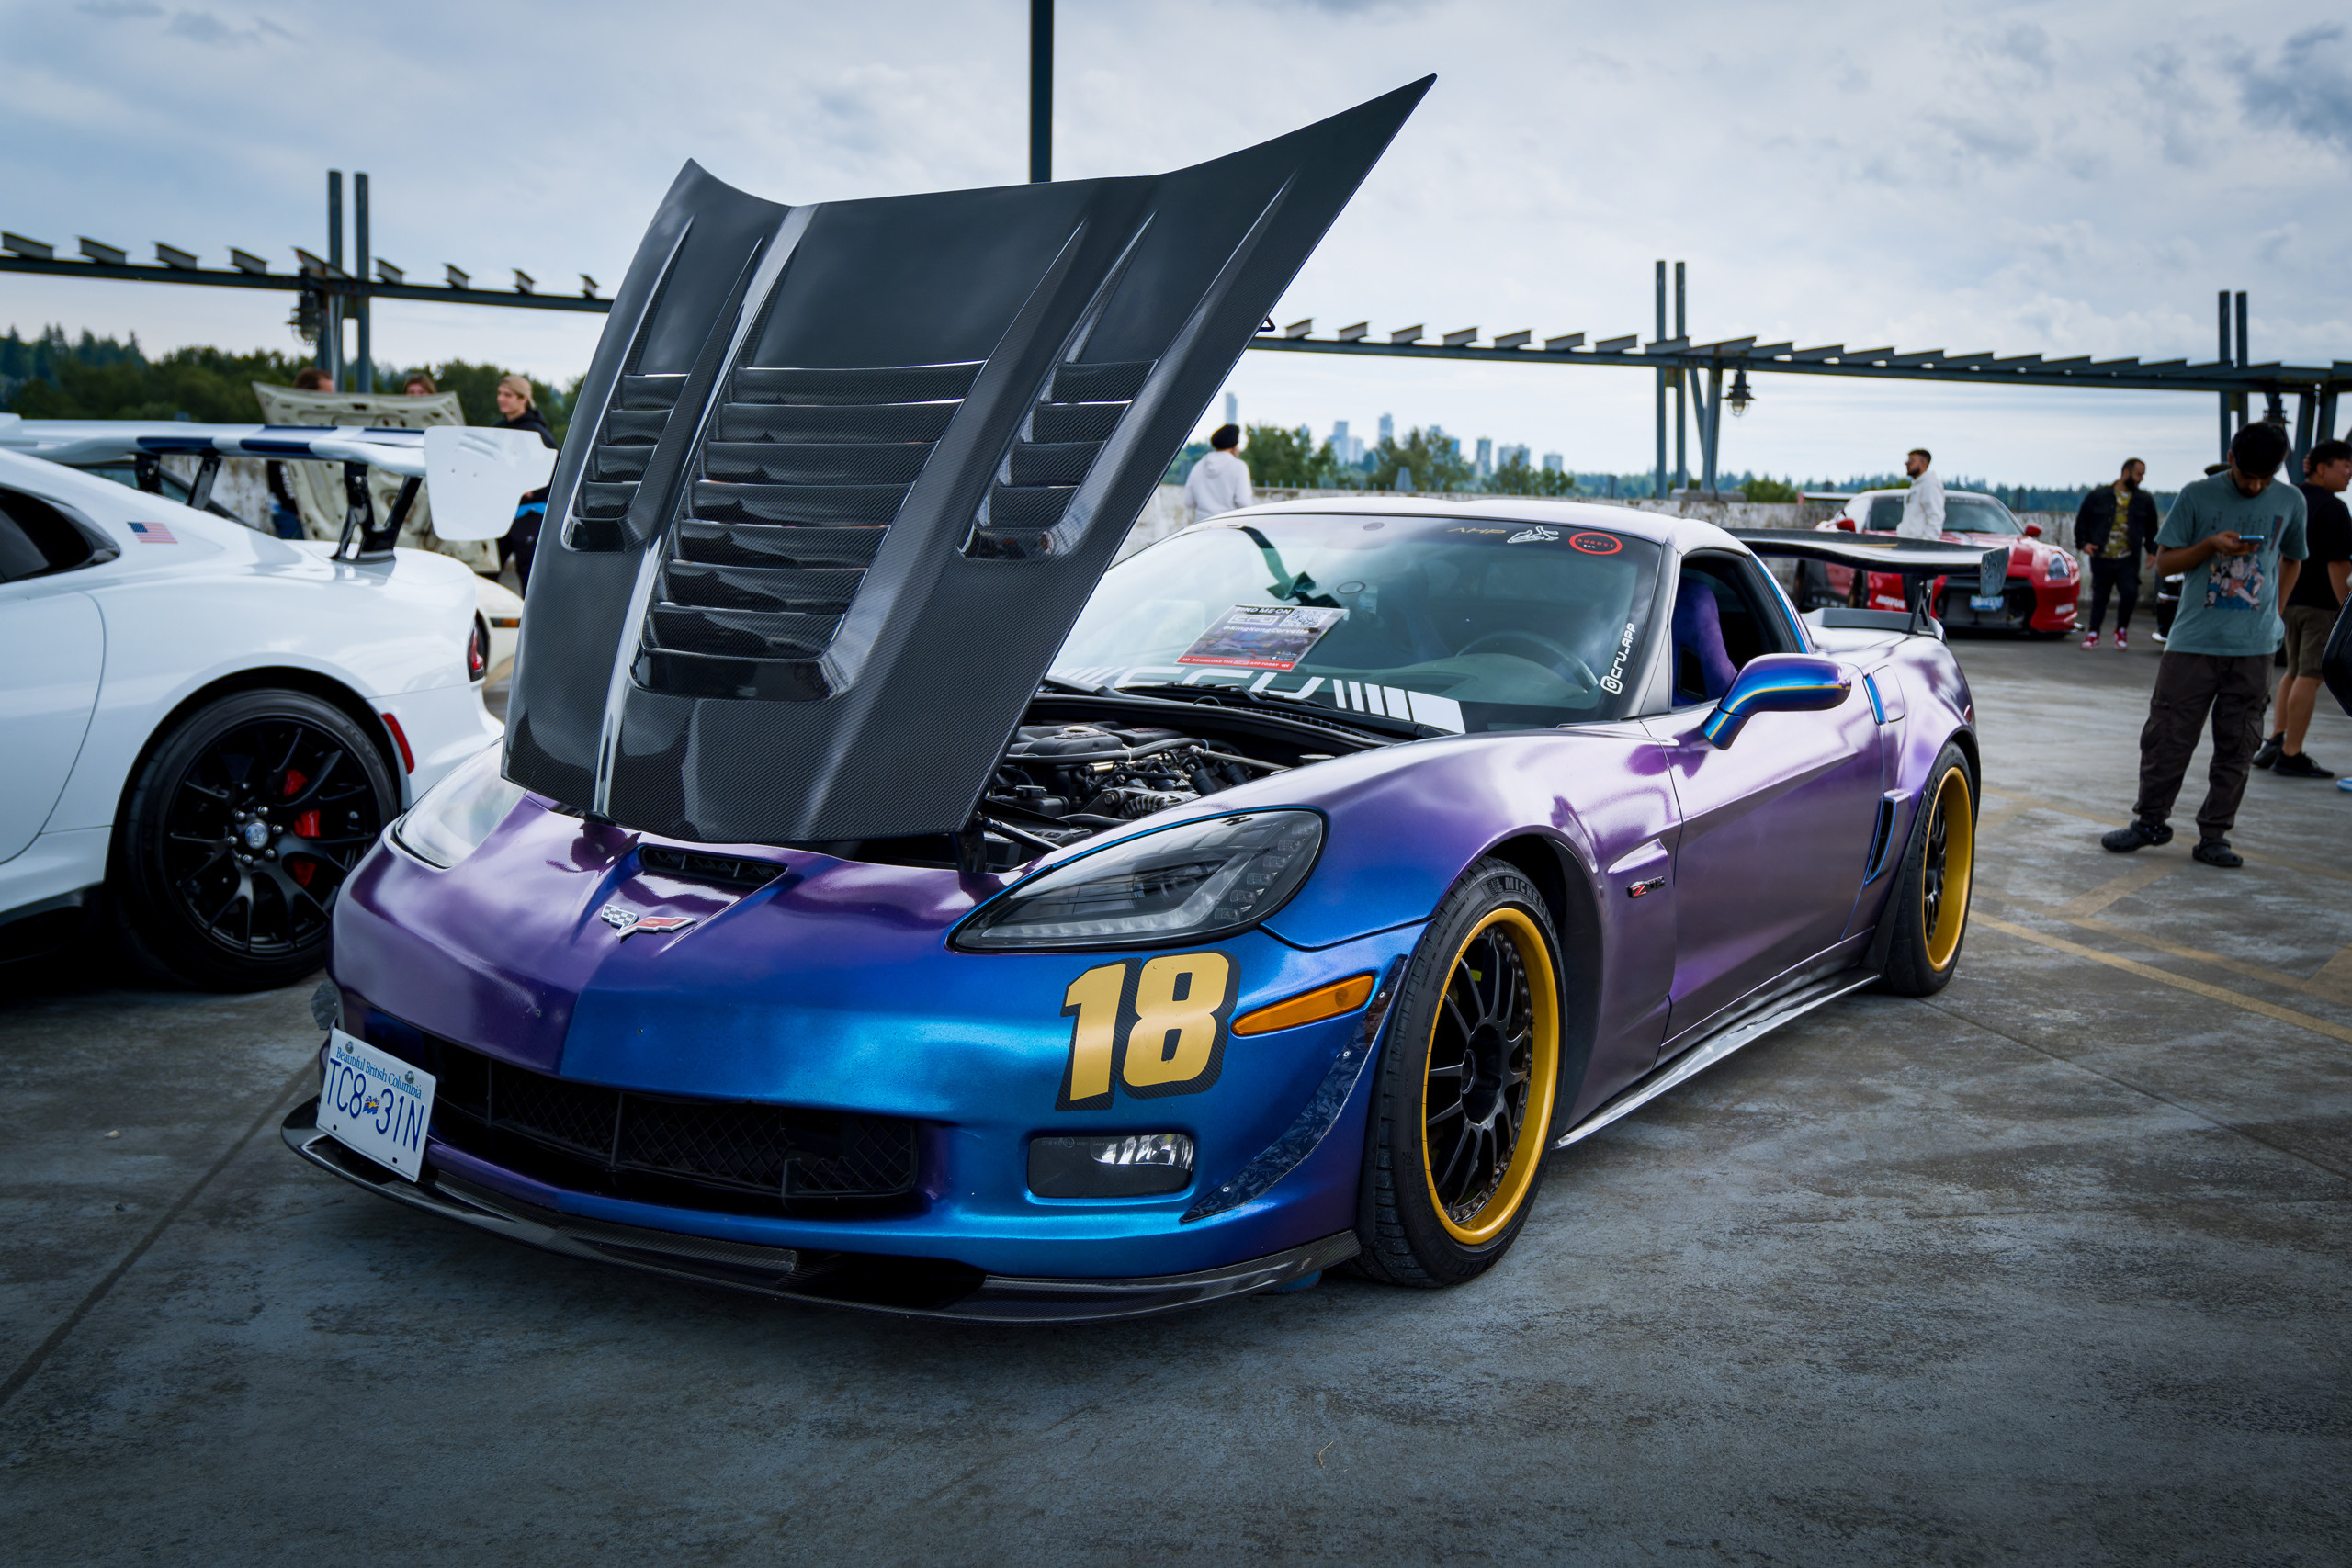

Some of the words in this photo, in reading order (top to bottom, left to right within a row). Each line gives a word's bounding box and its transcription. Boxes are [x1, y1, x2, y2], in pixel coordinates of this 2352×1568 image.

[336, 1046, 365, 1071] Beautiful
[365, 1061, 387, 1083] British
[388, 1072, 422, 1100] Columbia
[1061, 950, 1235, 1107] 18
[327, 1057, 367, 1119] TC8
[375, 1088, 424, 1153] 31N
